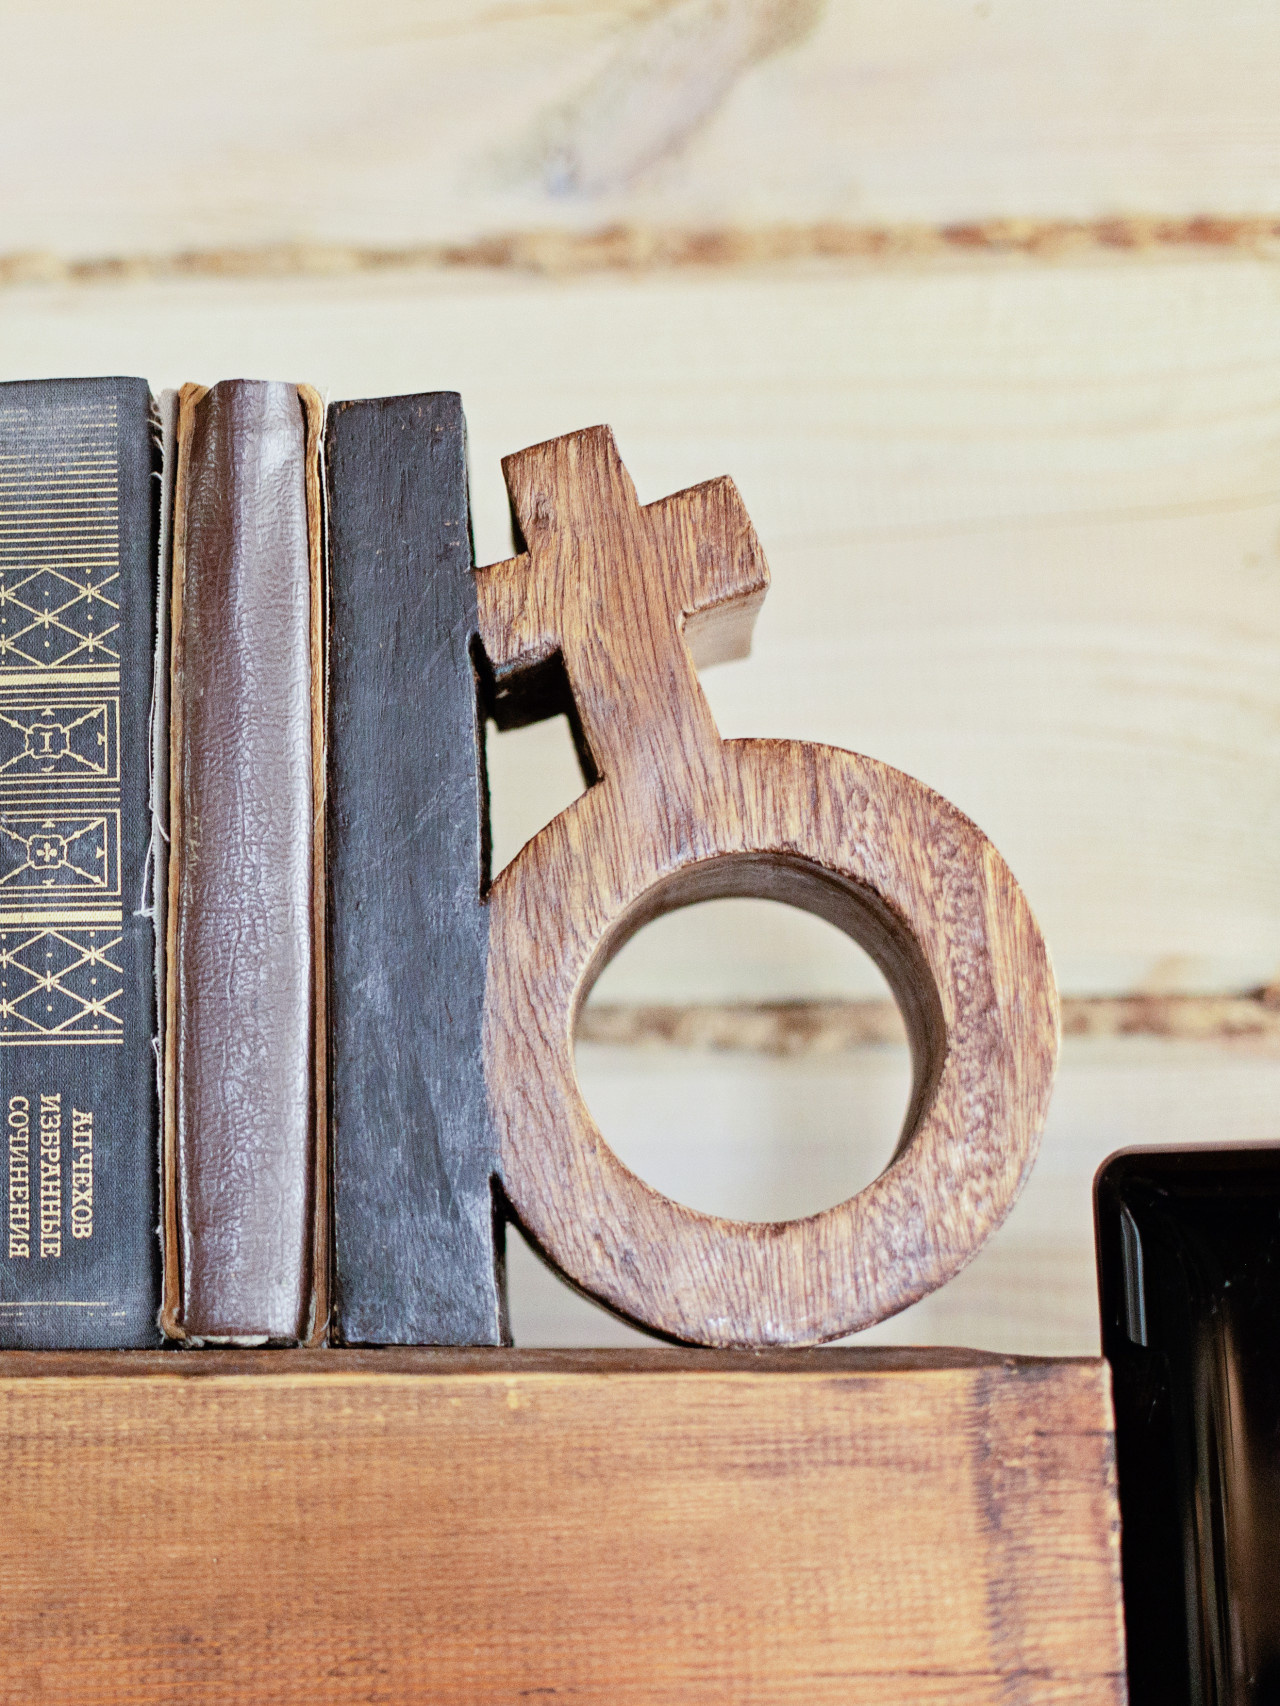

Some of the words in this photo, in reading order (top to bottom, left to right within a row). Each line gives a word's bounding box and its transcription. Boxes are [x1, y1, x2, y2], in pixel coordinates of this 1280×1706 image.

[40, 731, 53, 753] I
[8, 1096, 30, 1258] СОЧИНЕНИЯ
[40, 1093, 61, 1258] ИЗБРАННЫЕ
